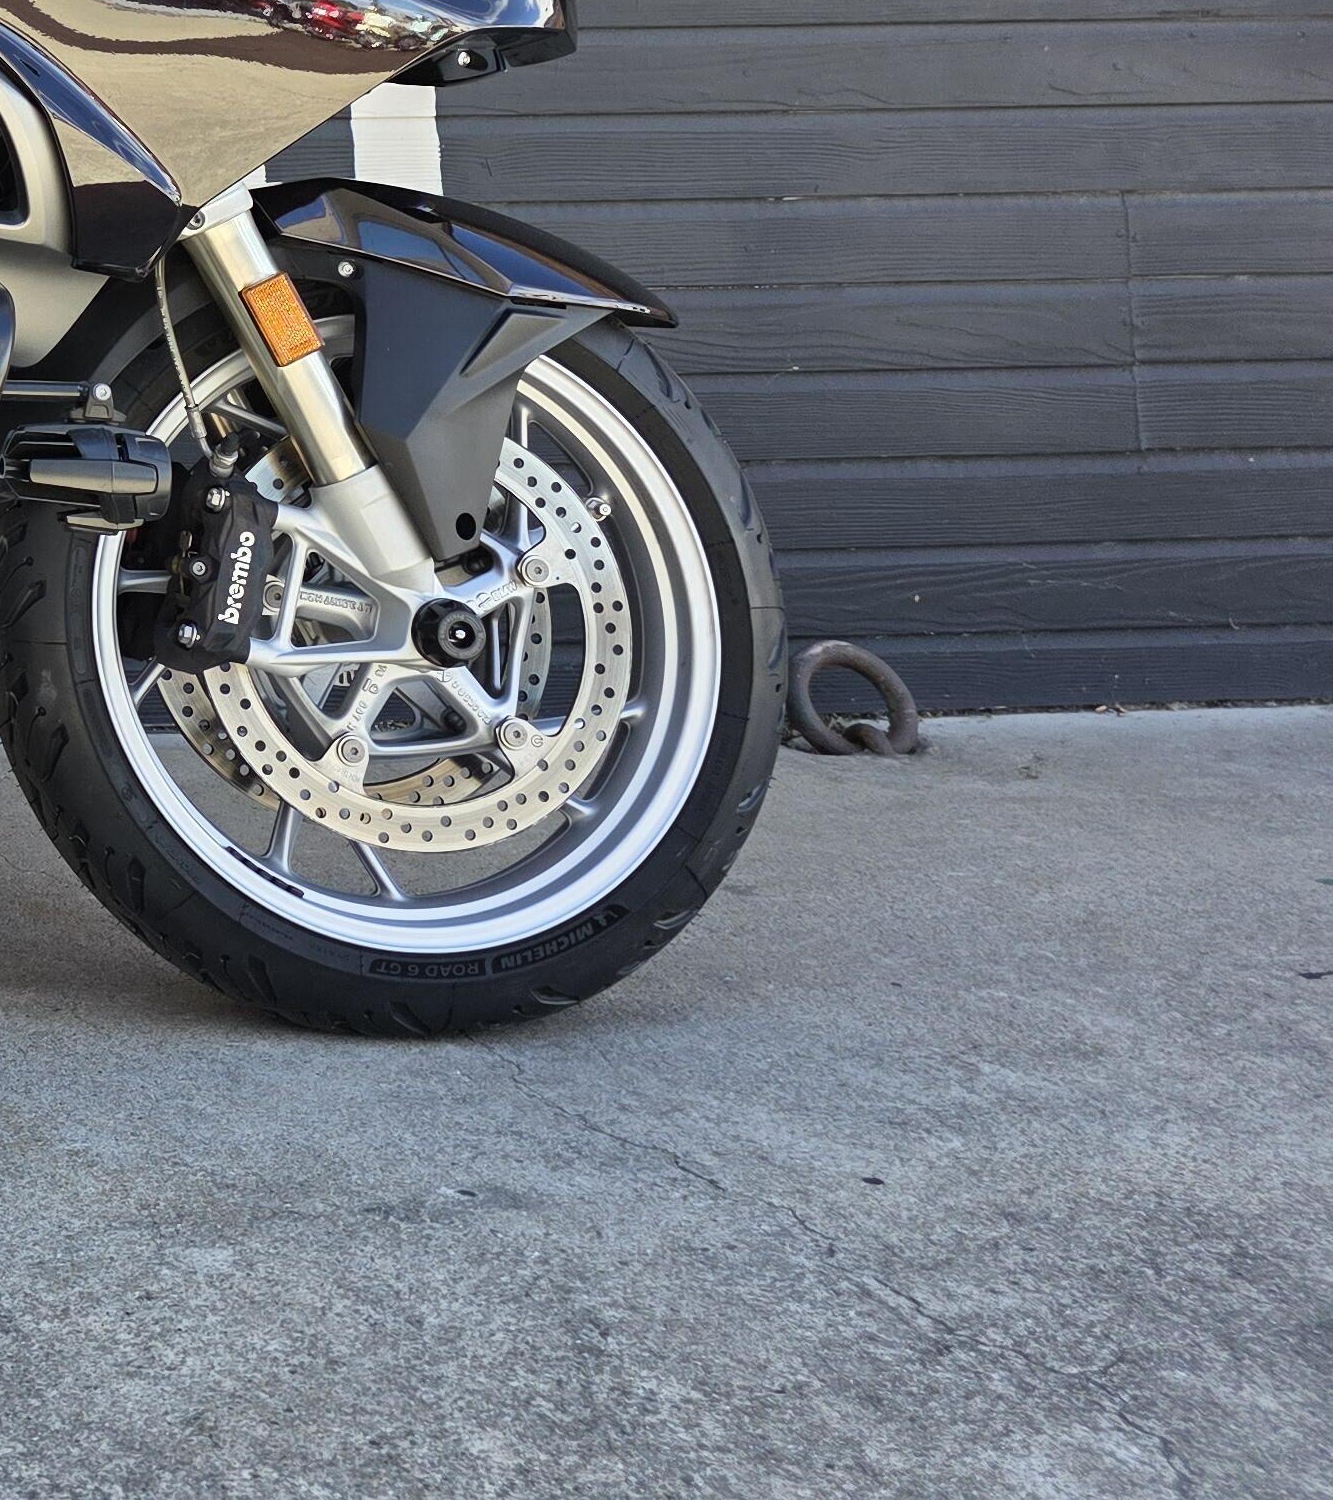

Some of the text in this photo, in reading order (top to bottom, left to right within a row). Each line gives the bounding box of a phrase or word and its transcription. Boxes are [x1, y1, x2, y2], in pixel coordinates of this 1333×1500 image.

[217, 530, 256, 625] brembo
[375, 961, 480, 977] ROAD 6 GT
[500, 924, 596, 970] MICHELIN
